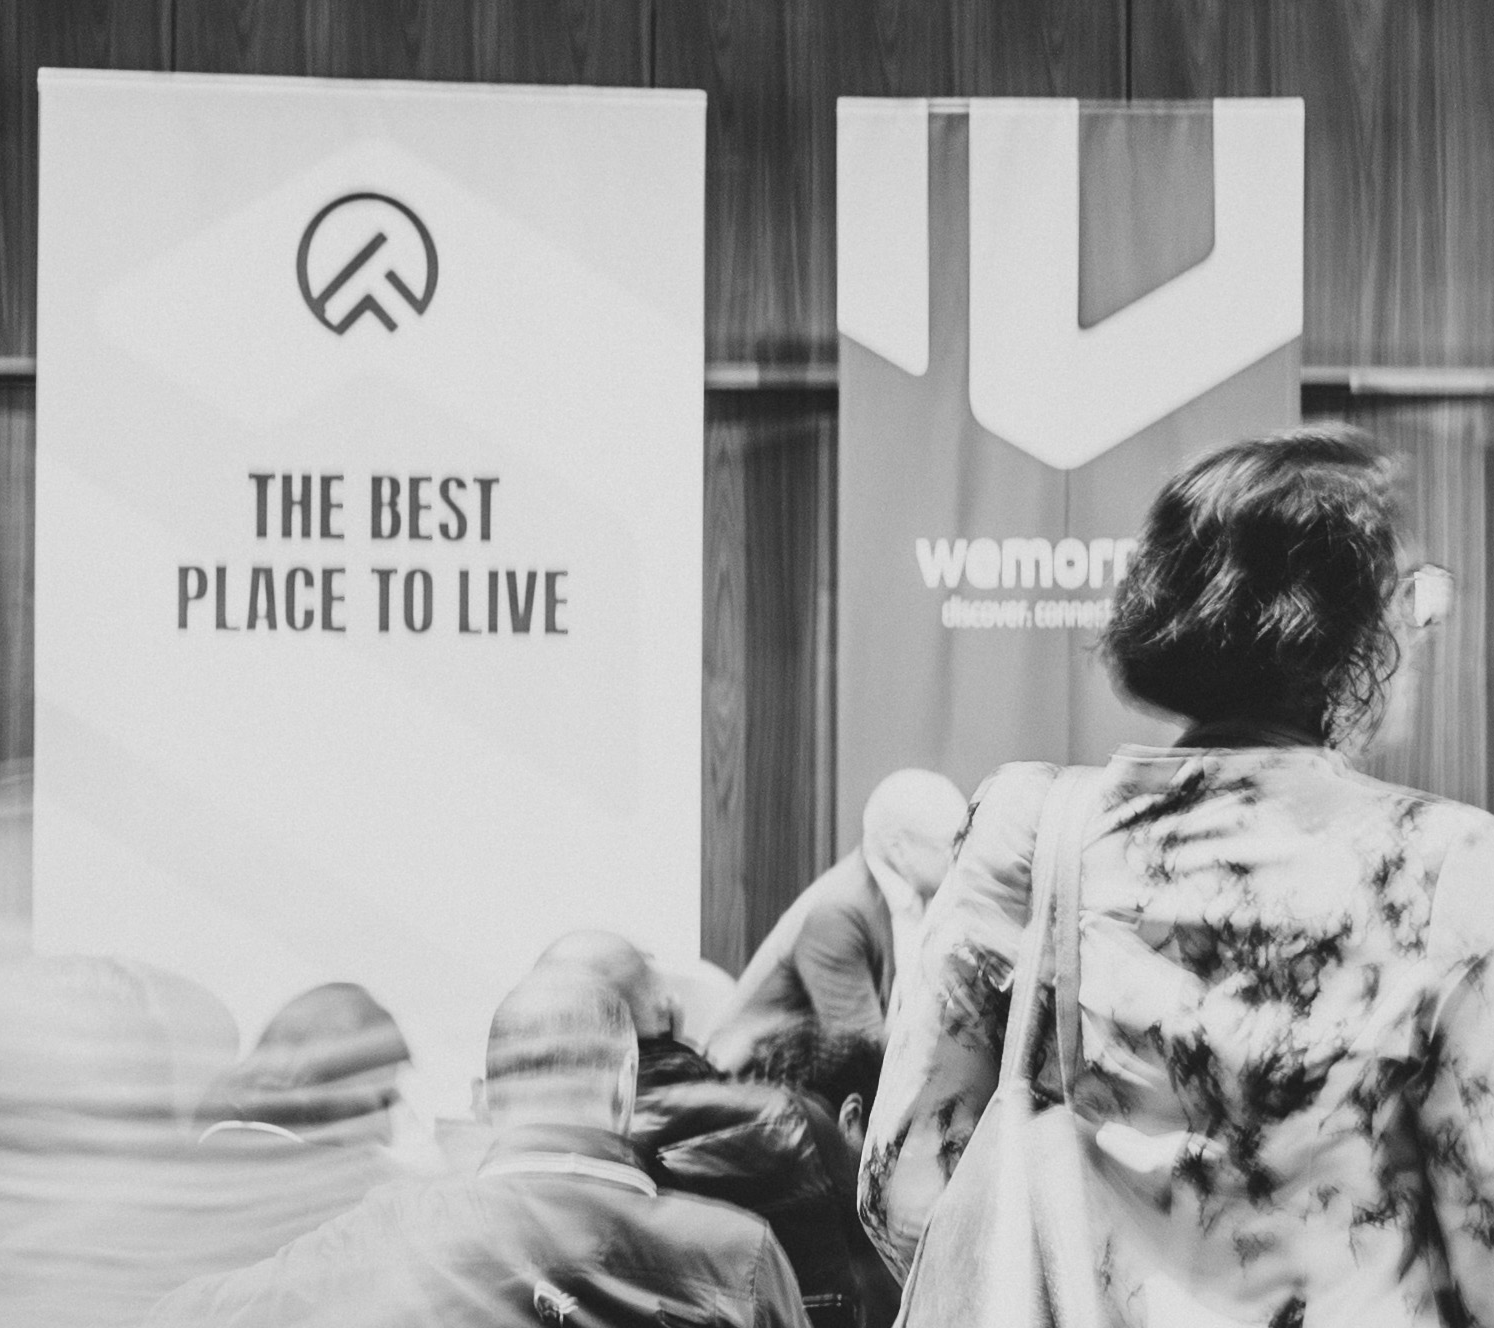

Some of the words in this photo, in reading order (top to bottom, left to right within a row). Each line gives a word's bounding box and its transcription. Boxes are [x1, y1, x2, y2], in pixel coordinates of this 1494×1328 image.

[246, 470, 346, 542] THE
[369, 473, 501, 543] BEST
[176, 563, 348, 635] PLACE
[369, 566, 435, 636] TO
[457, 567, 570, 637] LIVE
